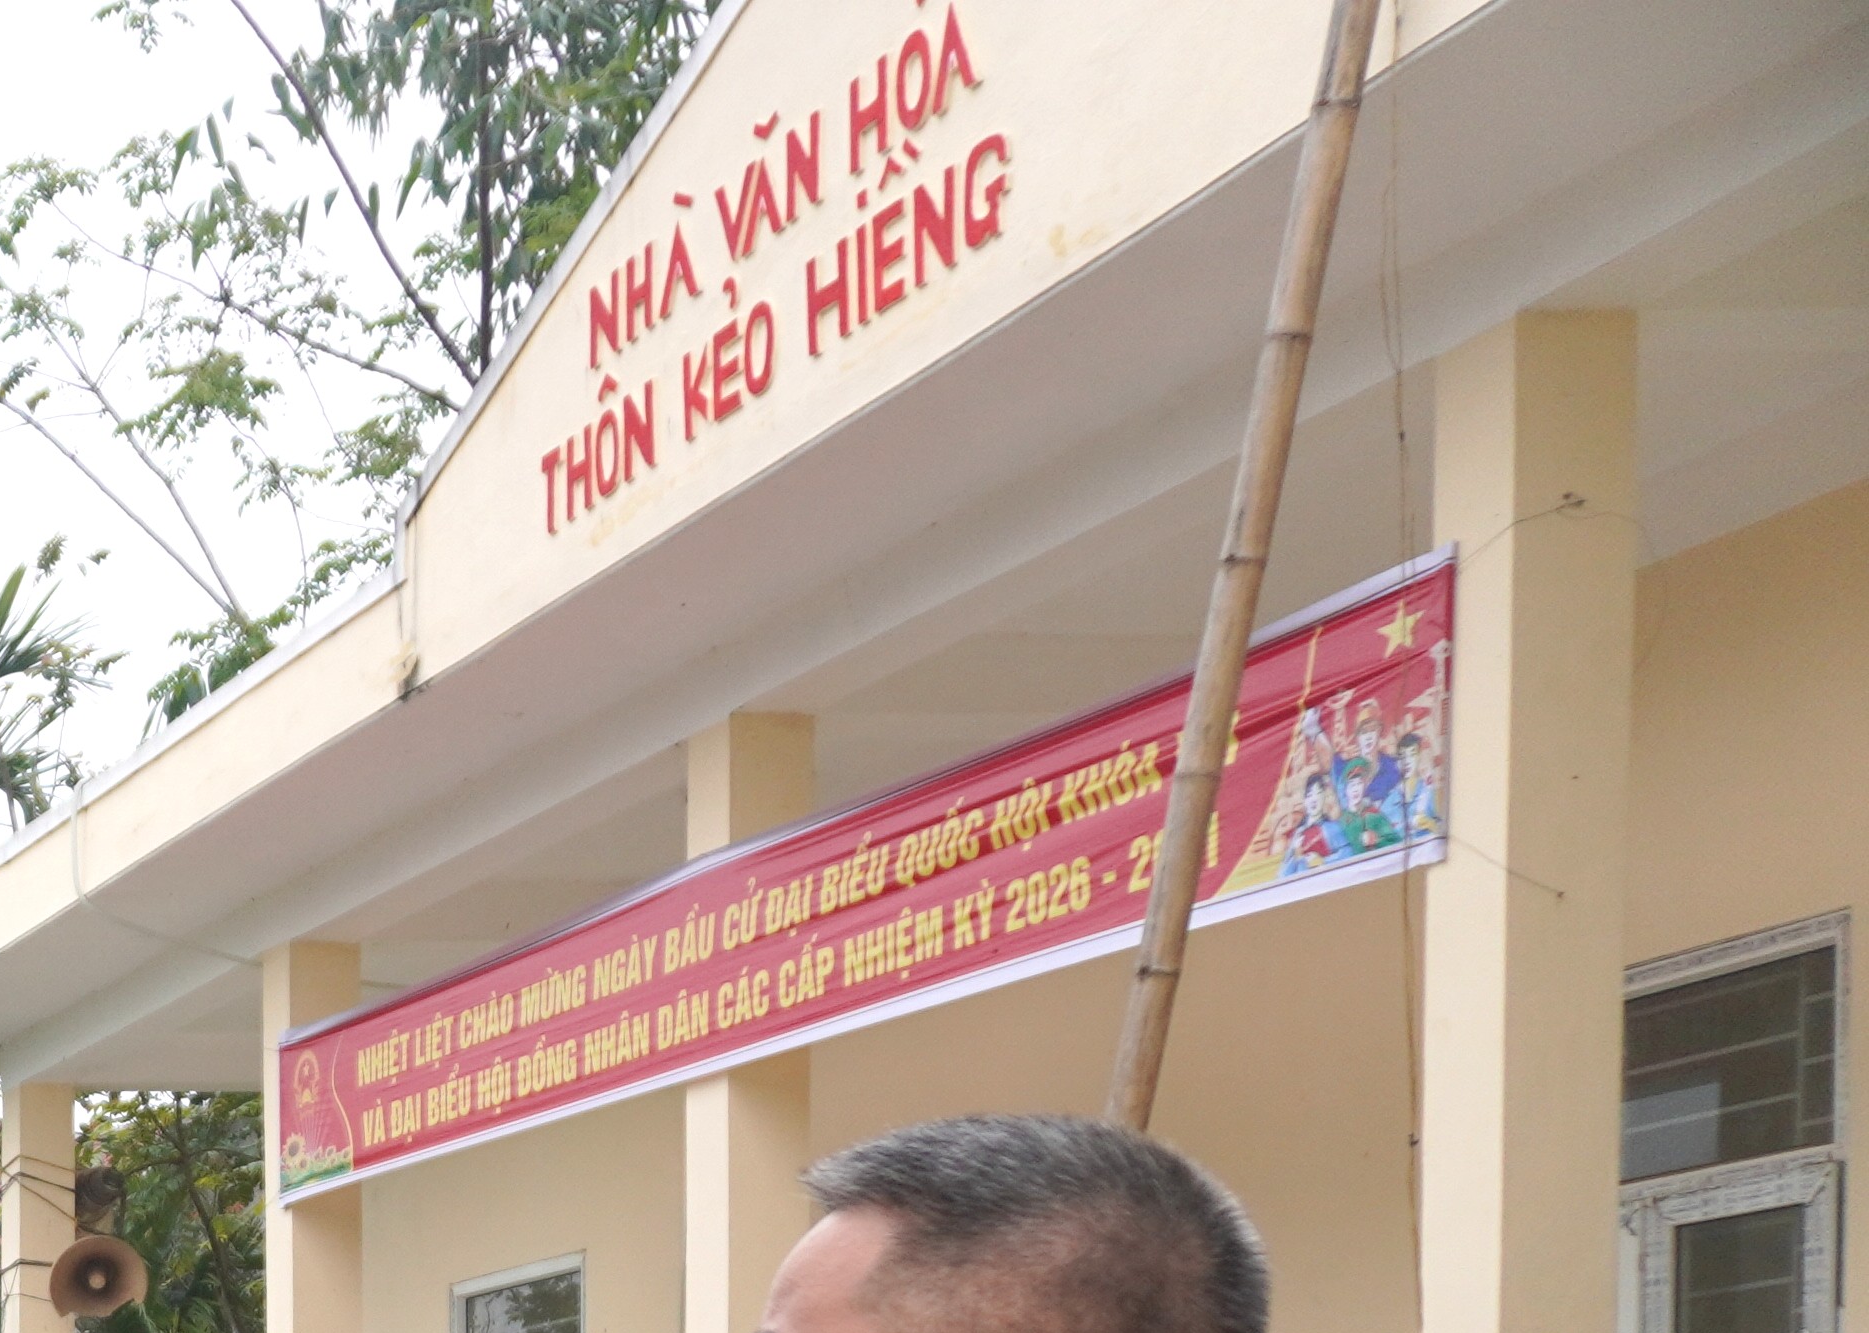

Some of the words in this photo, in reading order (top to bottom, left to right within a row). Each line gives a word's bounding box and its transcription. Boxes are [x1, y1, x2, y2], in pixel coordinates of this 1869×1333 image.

[542, 374, 656, 534] THÔN
[683, 276, 775, 441] KẺO
[805, 134, 1009, 356] HIỀNG
[589, 192, 701, 369] NHÀ
[715, 111, 822, 261] VĂN
[358, 1028, 408, 1086] NHIỆT
[415, 1012, 452, 1070] LIỆT
[460, 991, 514, 1049] CHÀO
[520, 967, 586, 1028] MỪNG
[593, 935, 658, 1000] NGÀY
[665, 903, 715, 974] BẦU
[723, 877, 763, 950] CỬ
[765, 874, 813, 937] ĐẠI
[820, 831, 890, 915] BIỂU
[895, 796, 984, 887] QUỐC
[989, 777, 1053, 851] HỘI
[1058, 740, 1162, 825] KHÓA
[362, 1101, 385, 1147] VÀ
[390, 1096, 421, 1143] ĐẠI
[427, 1064, 471, 1126] BIỂU
[477, 1056, 511, 1114] HỘI
[517, 1034, 577, 1098] ĐỒNG
[584, 1012, 650, 1075] NHÂN
[658, 984, 709, 1051] DÂN
[718, 964, 769, 1029] CÁC
[778, 934, 835, 1008] CẤP
[844, 906, 944, 987] NHIỆM
[953, 879, 996, 950] KỲ
[1006, 856, 1092, 933] 2026
